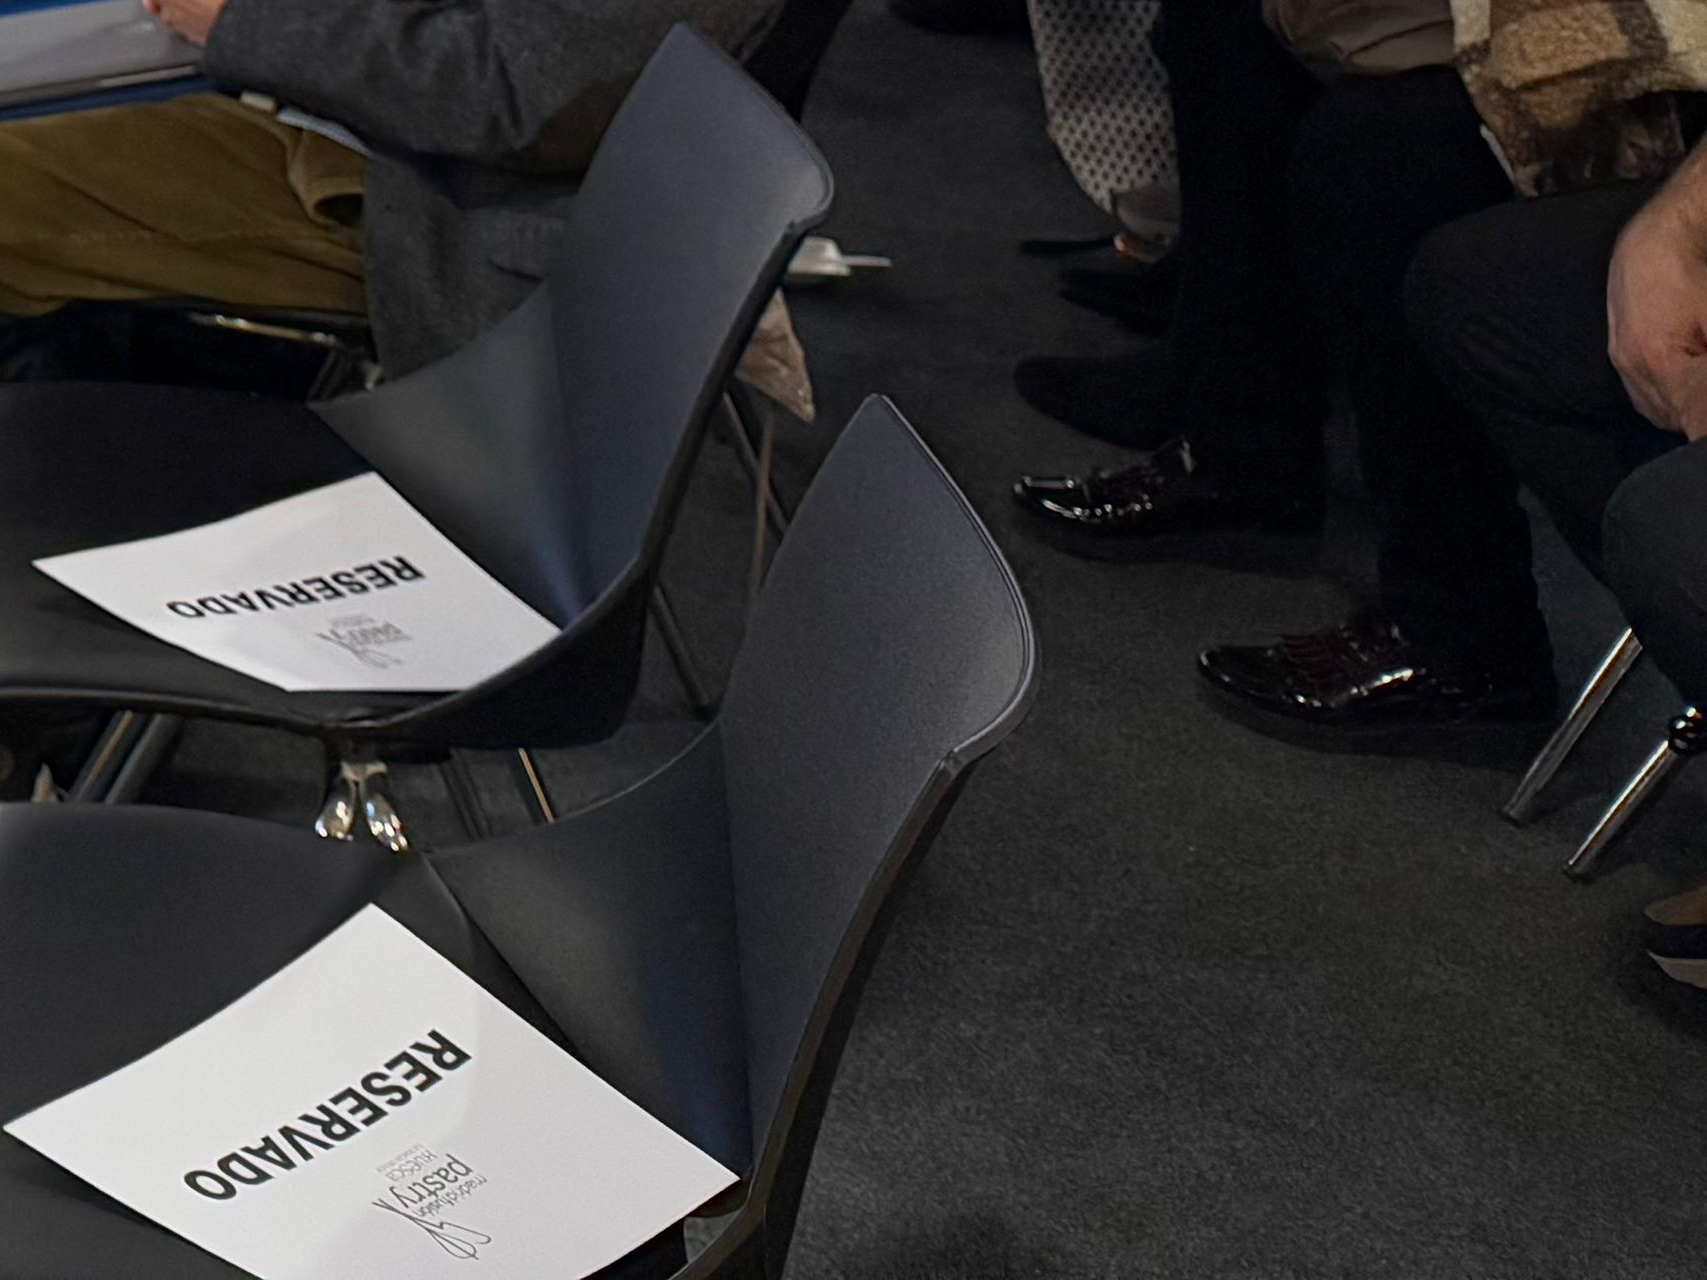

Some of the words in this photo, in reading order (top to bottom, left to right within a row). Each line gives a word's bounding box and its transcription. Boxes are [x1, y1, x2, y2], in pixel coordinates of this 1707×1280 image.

[167, 555, 426, 619] RESERVADO
[183, 1028, 473, 1200] RESERVADO
[389, 1153, 474, 1208] pastry
[411, 1173, 488, 1219] madridfusión
